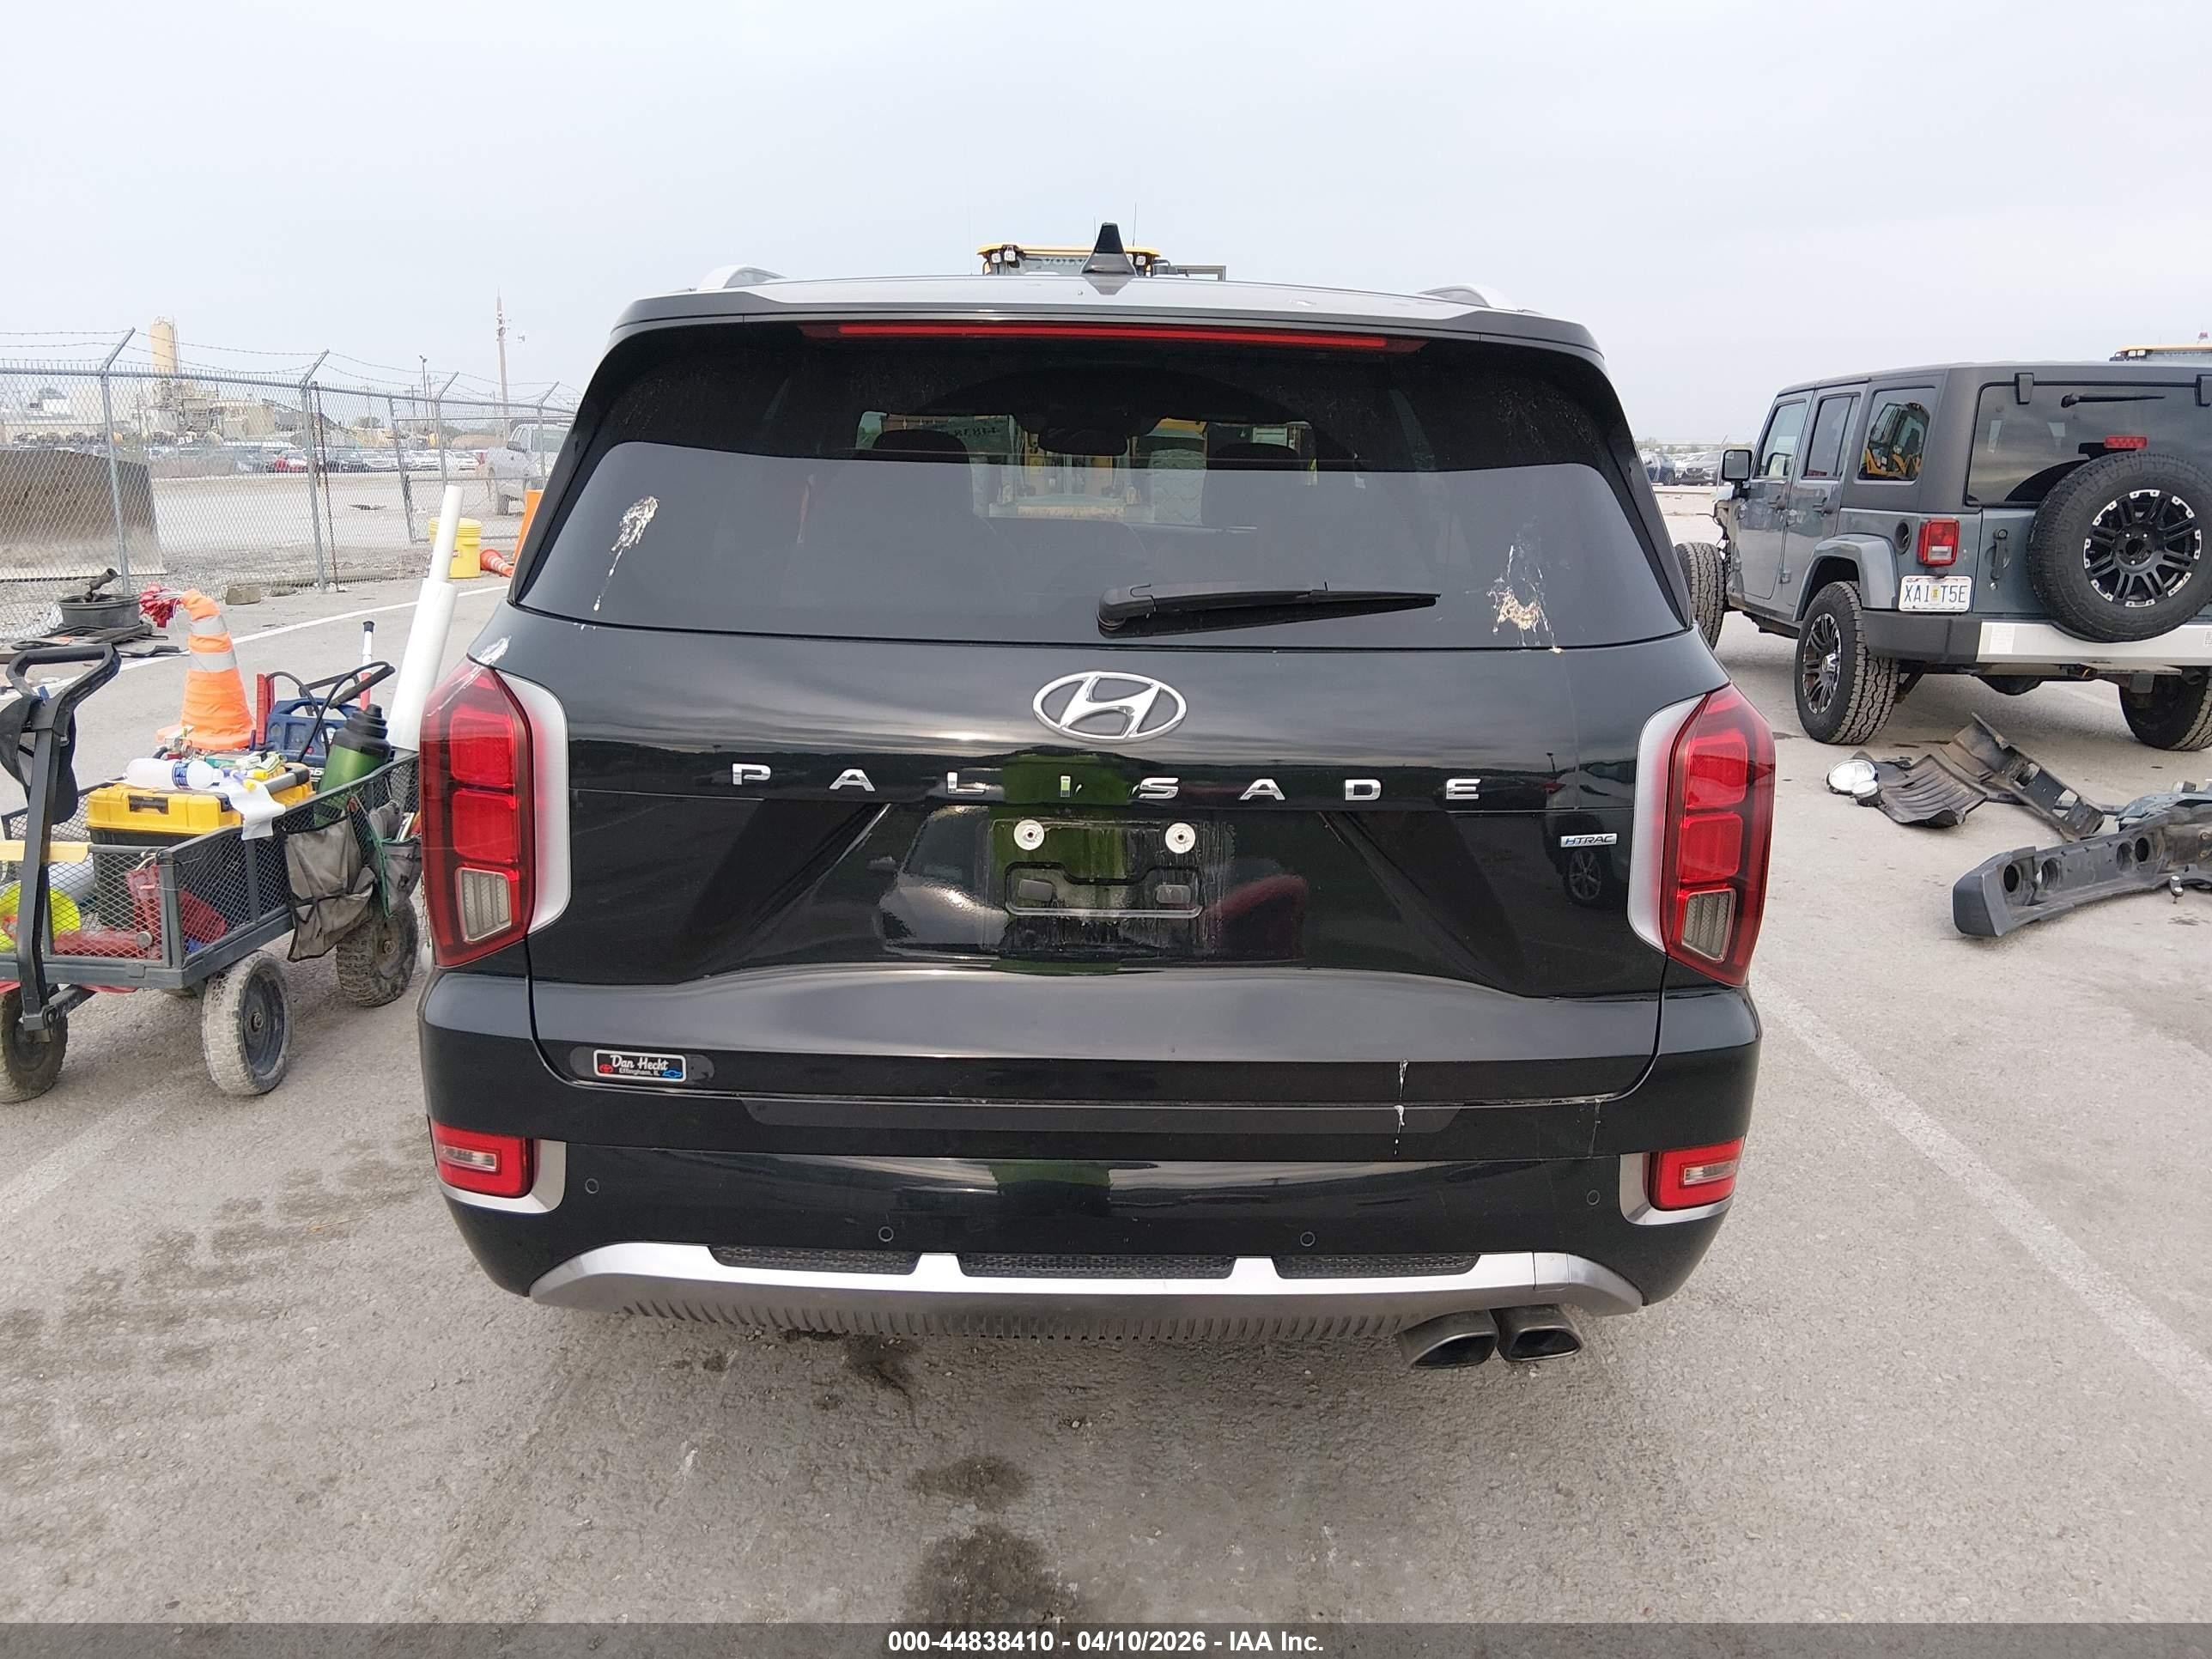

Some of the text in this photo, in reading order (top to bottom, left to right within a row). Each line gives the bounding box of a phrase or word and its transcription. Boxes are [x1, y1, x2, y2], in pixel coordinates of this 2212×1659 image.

[1042, 257, 1088, 266] VOLV
[1904, 584, 1929, 603] XA1
[1941, 585, 1968, 603] T5E
[732, 763, 1481, 801] PALISADE
[1565, 836, 1613, 845] HTRAC
[610, 1054, 669, 1071] Dan Hecht
